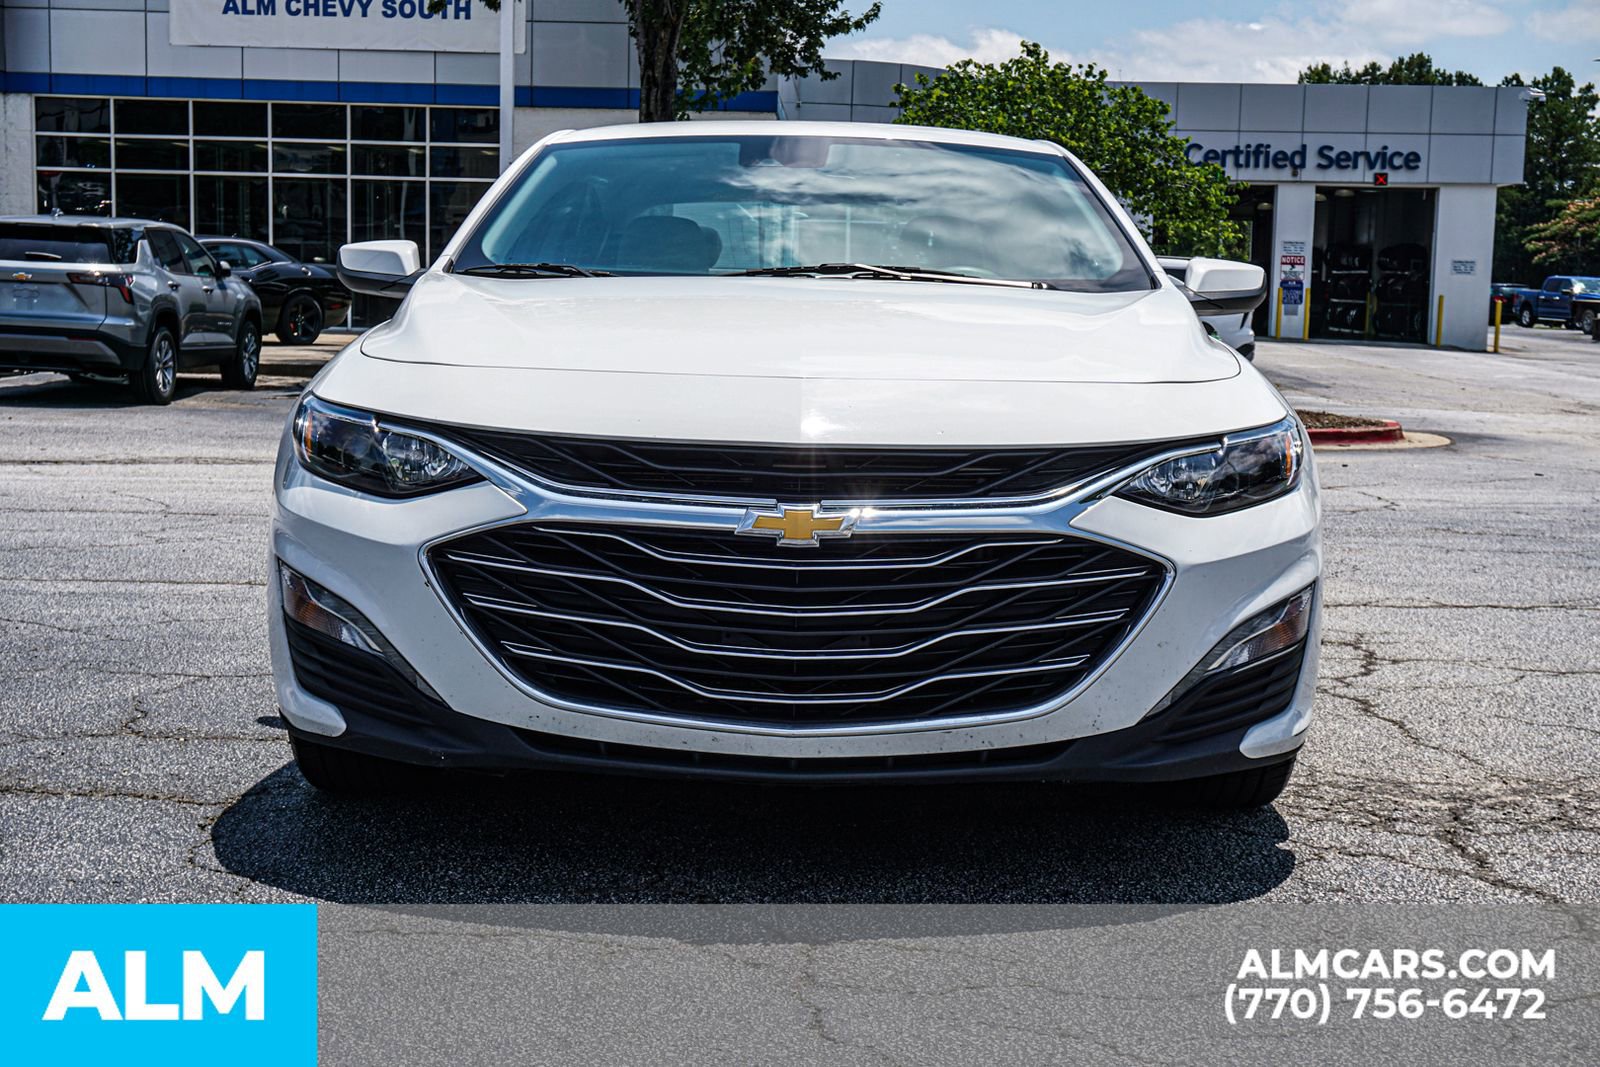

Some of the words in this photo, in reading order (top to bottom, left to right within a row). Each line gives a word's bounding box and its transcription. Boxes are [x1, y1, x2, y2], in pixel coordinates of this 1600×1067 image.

[222, 0, 276, 16] ALM
[285, 0, 374, 17] CHEVY
[1186, 143, 1306, 169] Certified
[1316, 145, 1421, 171] Service
[1281, 256, 1304, 264] NOTICE
